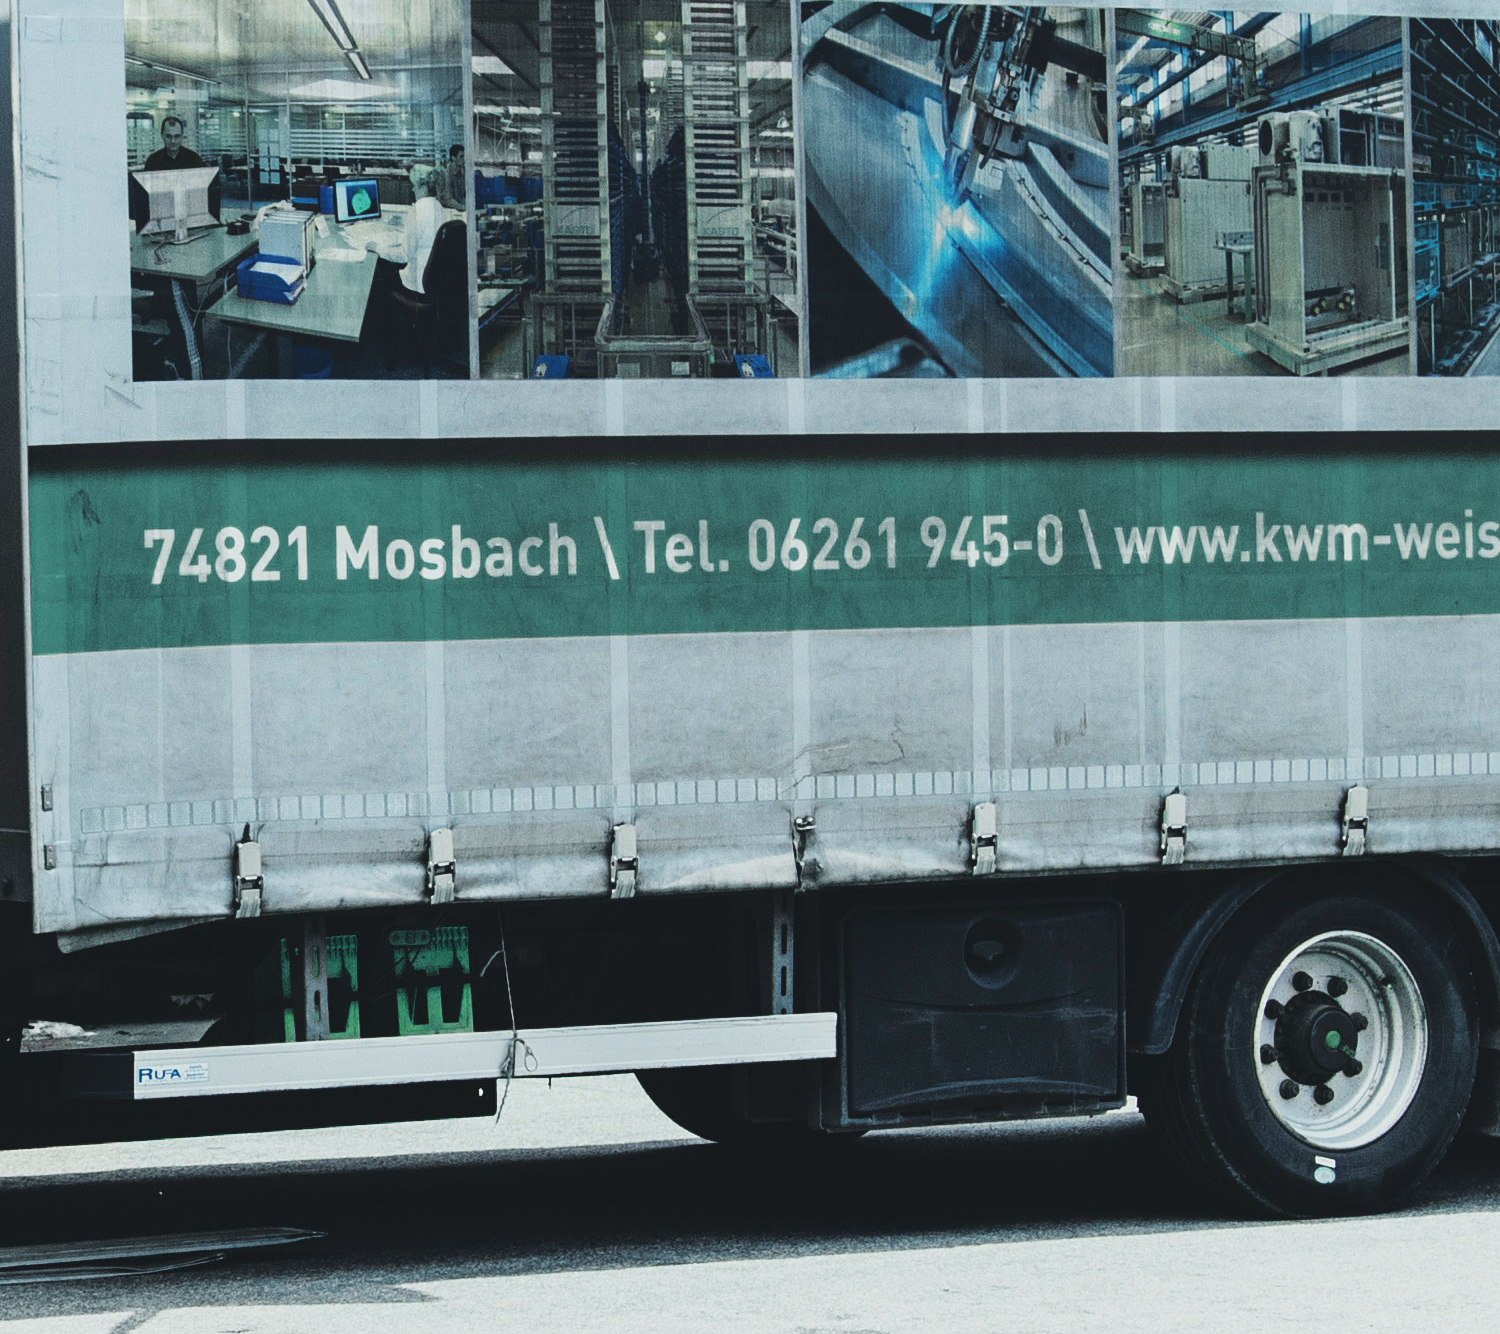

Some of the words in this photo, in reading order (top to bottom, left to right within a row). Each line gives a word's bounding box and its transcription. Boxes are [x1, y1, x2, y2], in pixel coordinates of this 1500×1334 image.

[144, 524, 311, 585] 74821
[335, 521, 578, 581] Mosbach
[634, 519, 730, 574] Tel.
[748, 515, 901, 572] 06261
[920, 514, 1063, 570] 945-0
